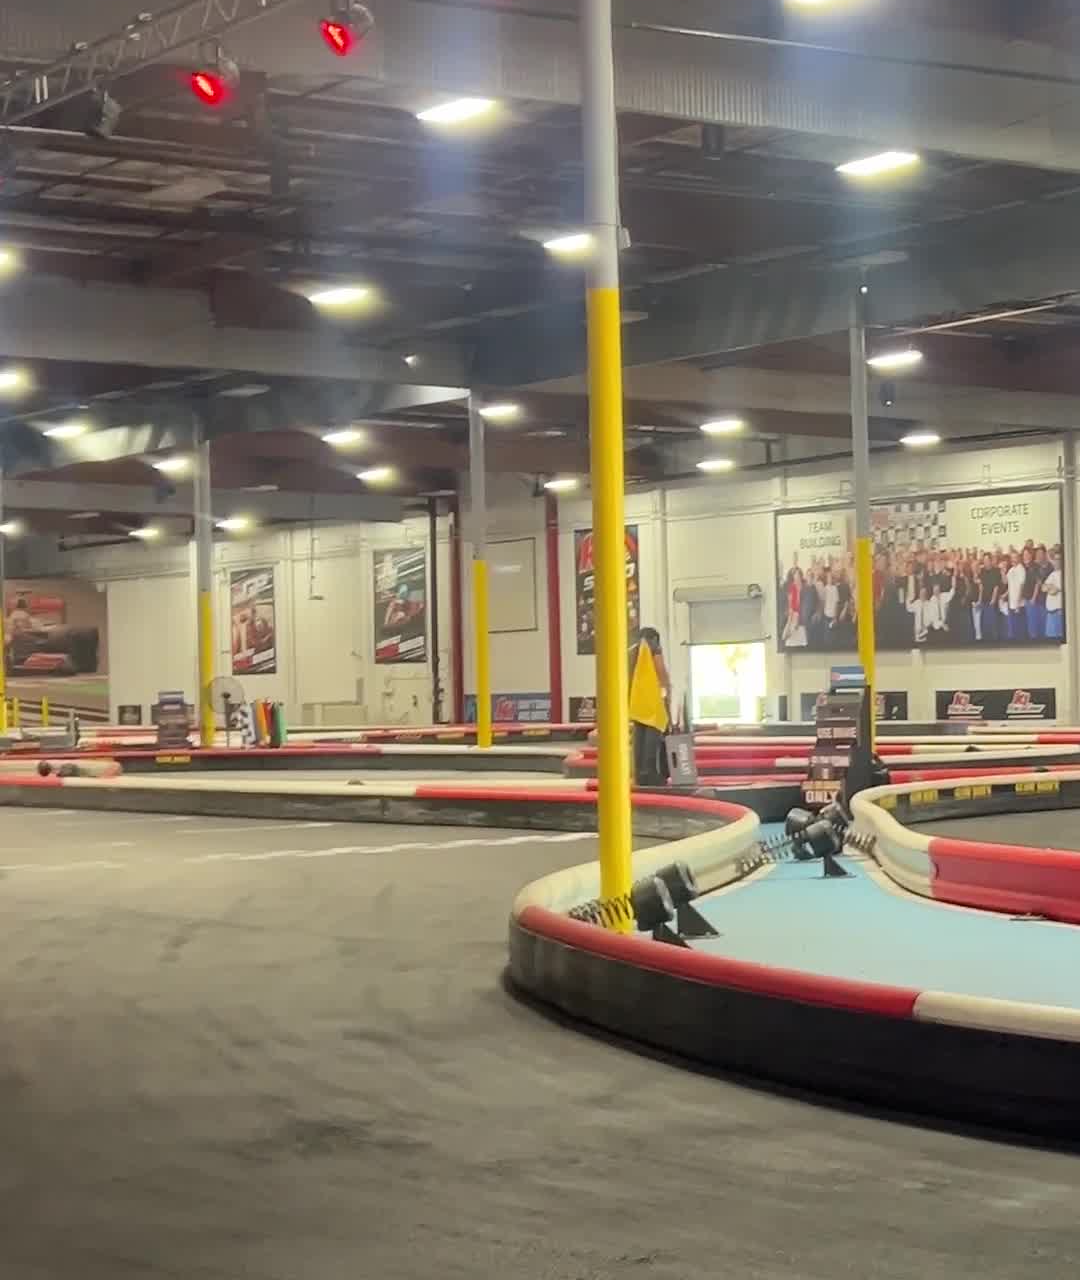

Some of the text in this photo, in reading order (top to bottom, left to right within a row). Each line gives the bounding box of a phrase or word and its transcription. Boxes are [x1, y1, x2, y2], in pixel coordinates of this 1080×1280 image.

[971, 503, 1029, 520] CORPORATE
[807, 521, 833, 533] TEAM
[981, 524, 1020, 536] EVENTS
